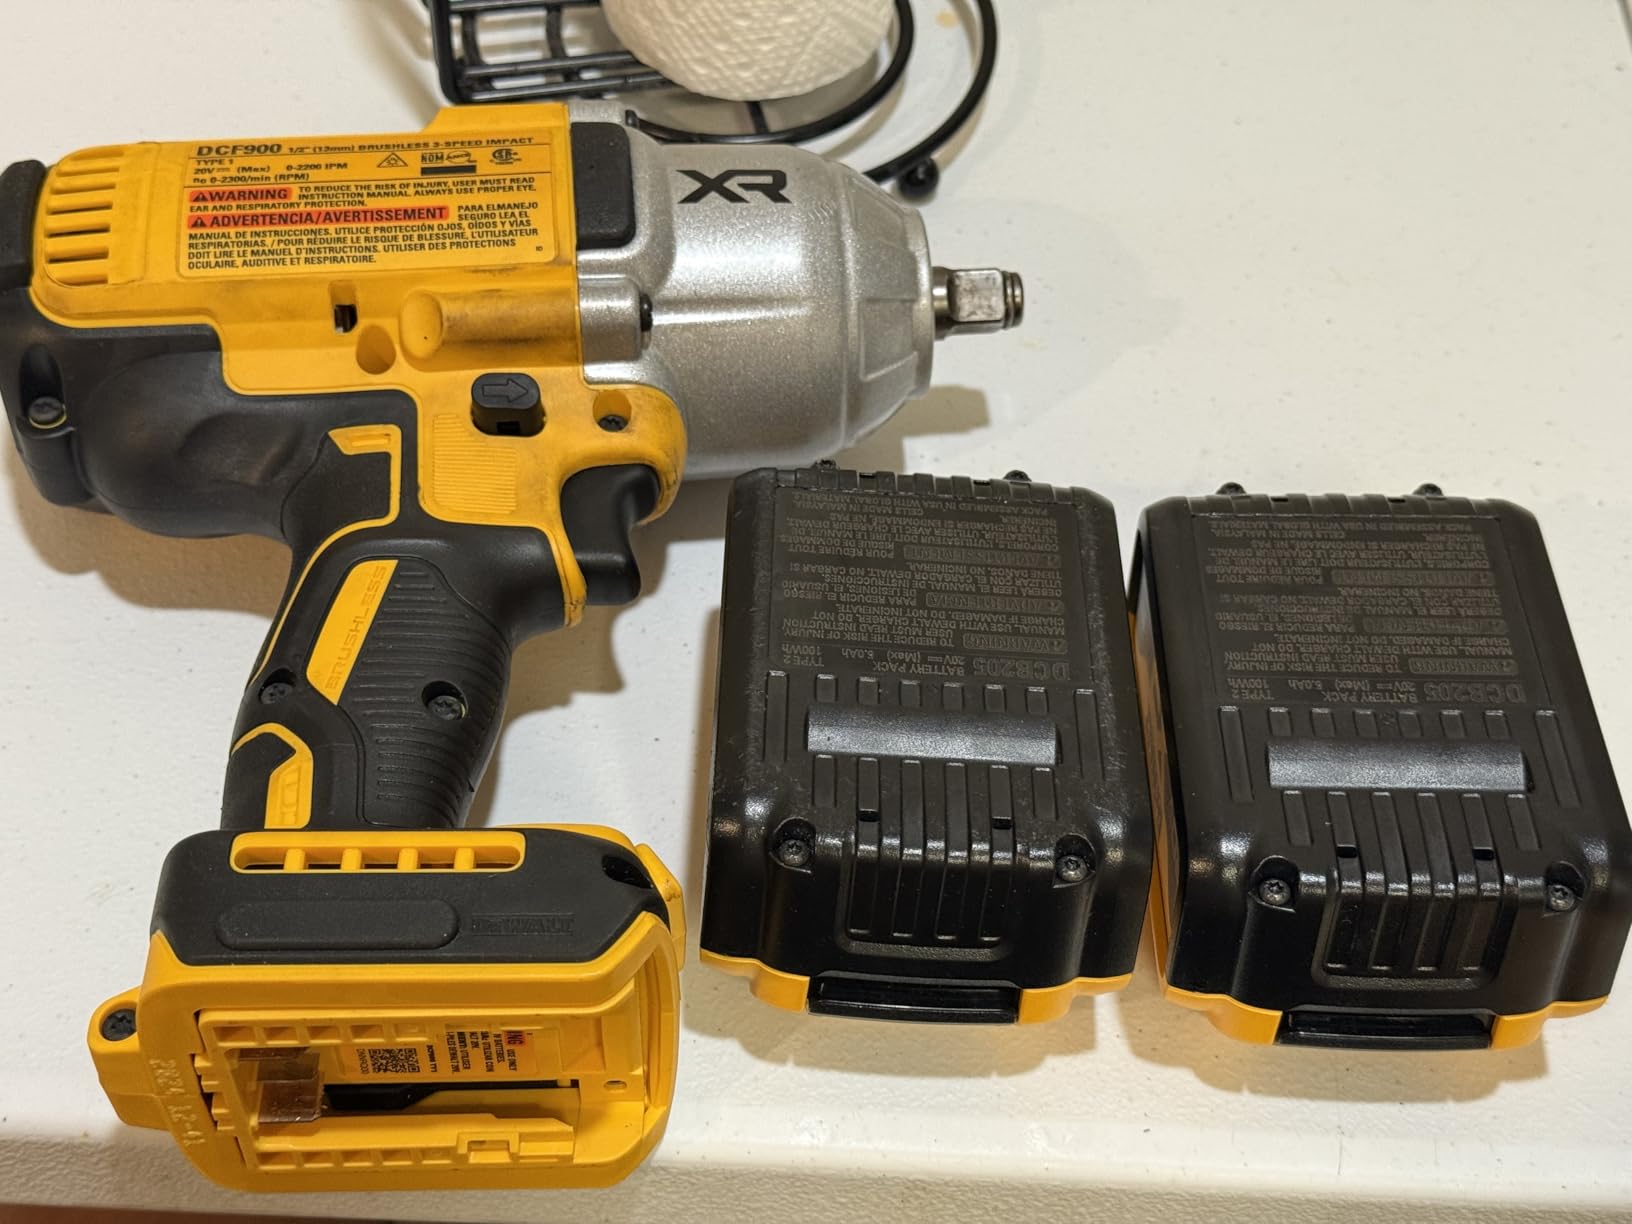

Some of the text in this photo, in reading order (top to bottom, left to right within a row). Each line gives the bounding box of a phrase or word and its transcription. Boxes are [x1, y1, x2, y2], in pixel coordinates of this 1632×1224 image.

[197, 144, 282, 156] DCF900
[359, 141, 430, 150] BRUSHLESS
[275, 173, 309, 182] (RPM)
[209, 189, 287, 201] WARNING
[375, 183, 396, 191] RISK
[480, 178, 507, 186] MUST
[299, 192, 363, 200] INSTRUCTION
[414, 187, 451, 196] ALWAYS
[478, 185, 514, 193] PROPER
[676, 169, 792, 204] XR
[236, 200, 300, 211] RESPIRATORY
[304, 199, 367, 209] PROTECTION.
[458, 212, 496, 221] SEGURO
[499, 211, 516, 219] LEA
[189, 232, 232, 241] MANUAL
[235, 231, 247, 239] DE
[250, 228, 330, 238] INSTRUCCIONES.
[335, 226, 371, 235] UTILICE
[374, 223, 434, 234] PROTECCIÓN
[438, 223, 465, 231] OJOS,
[468, 221, 498, 229] OÍDOS
[510, 218, 531, 227] VÍAS
[188, 240, 268, 250] RESPIRATORIAS.
[308, 236, 348, 245] RÉDUIRE
[365, 235, 399, 244] RISQUE
[418, 232, 468, 241] BLESSURE,
[471, 228, 538, 239] L'UTILISATEUR
[188, 252, 211, 260] DOIT
[214, 251, 234, 259] LIRE
[251, 248, 293, 257] MANUEL
[296, 245, 381, 255] D'INSTRUCTIONS.
[383, 243, 426, 252] UTILISER
[428, 242, 447, 250] DES
[450, 239, 516, 249] PROTECTIONS
[188, 255, 376, 270] OCULAIRE, AUDITIVE ET RESPIRATOIRE.
[325, 565, 387, 689] BRUSHLESS
[959, 621, 989, 630] WITH
[990, 623, 1011, 632] USE
[844, 632, 868, 641] RISK
[871, 633, 891, 642] THE
[940, 639, 953, 647] TO
[794, 656, 824, 667] TYPE
[887, 651, 920, 661] (Max)
[873, 660, 905, 673] PACK
[907, 662, 964, 676] BATTERY
[973, 657, 1070, 680] DCB205
[1321, 691, 1357, 701] PACK
[1361, 692, 1418, 703] BATTERY
